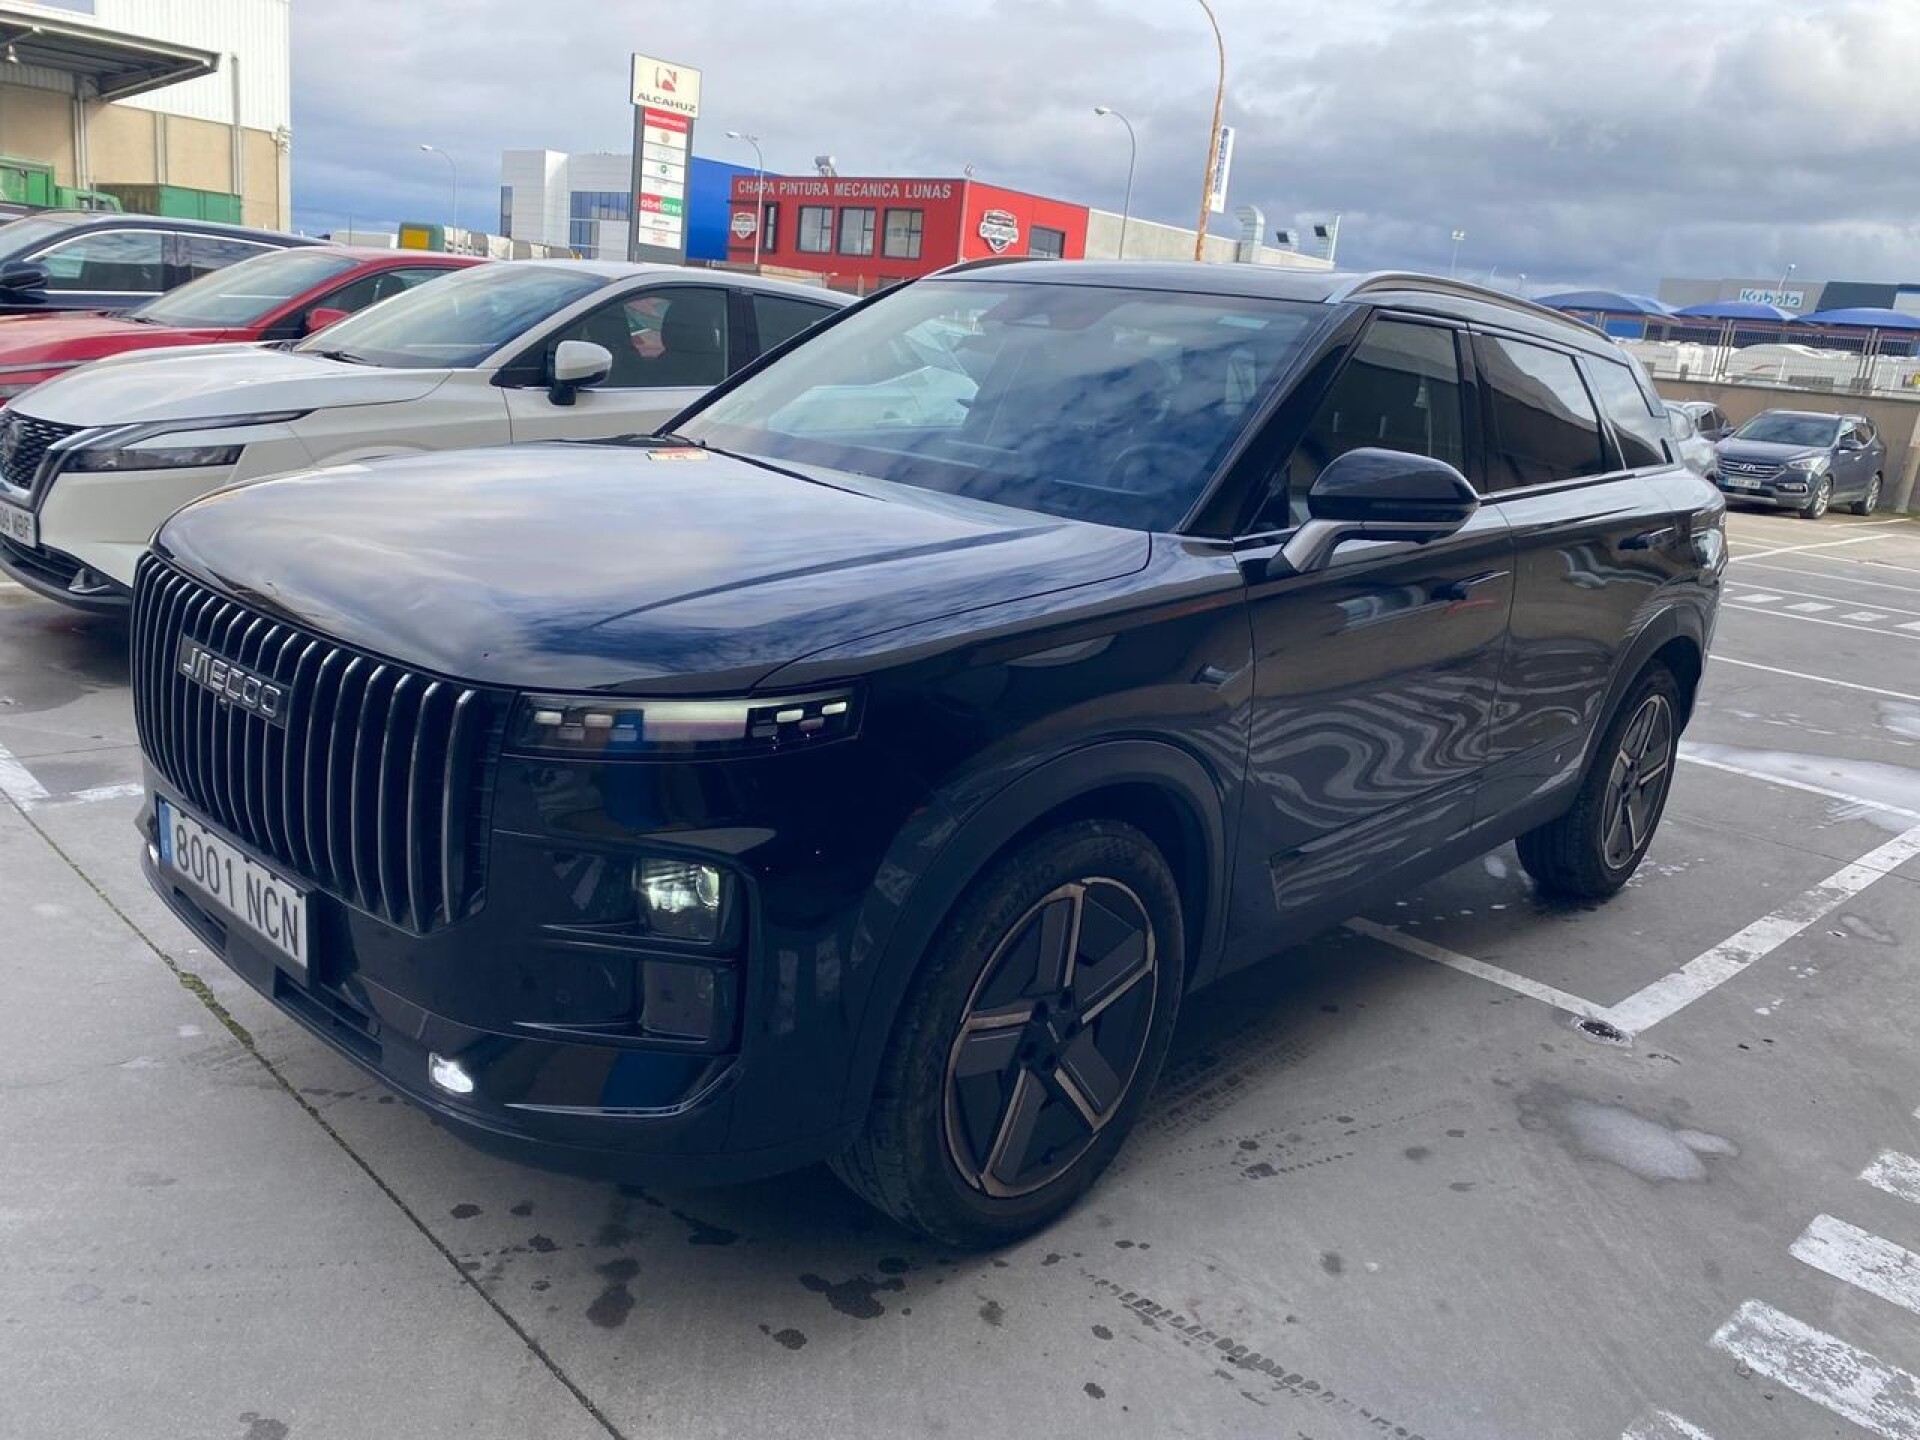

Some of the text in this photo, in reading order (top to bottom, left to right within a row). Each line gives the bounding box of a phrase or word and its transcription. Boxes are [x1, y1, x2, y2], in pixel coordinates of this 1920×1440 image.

[637, 92, 697, 114] ALCAHUZ
[738, 180, 951, 199] CHAPA PINTURA MECANICA LUNAS
[183, 647, 281, 718] JAECOO
[176, 824, 235, 908] 8001
[246, 869, 299, 957] NCN
